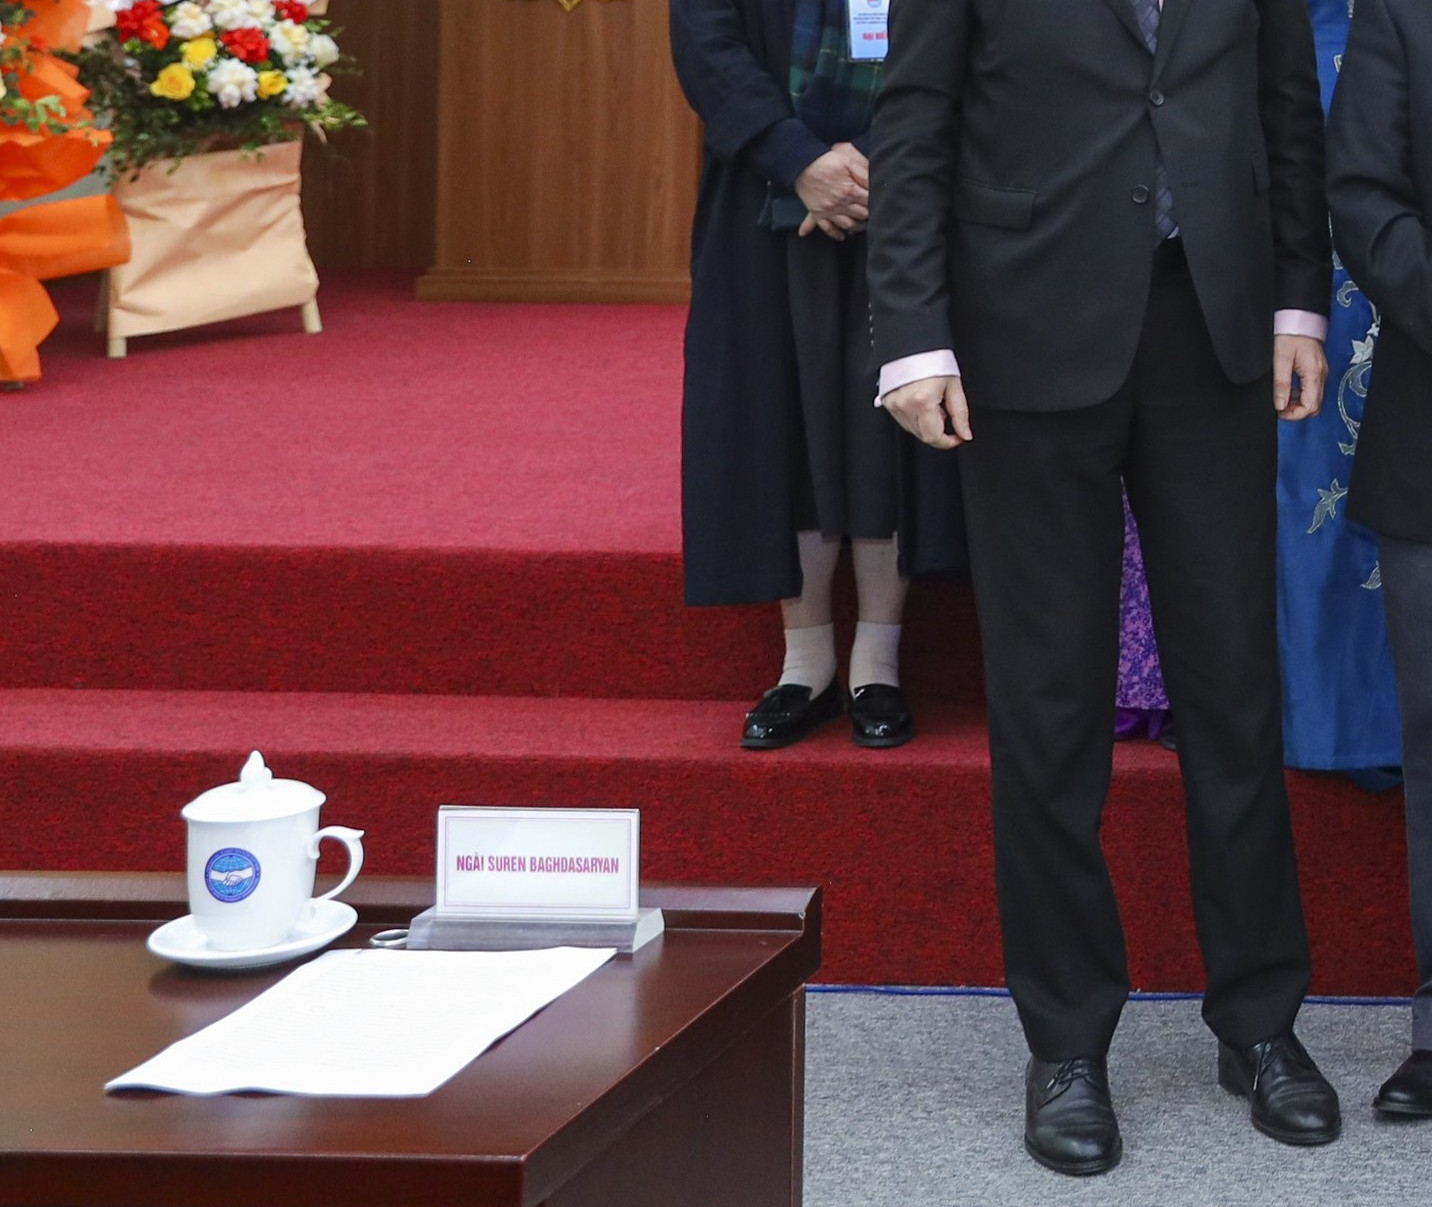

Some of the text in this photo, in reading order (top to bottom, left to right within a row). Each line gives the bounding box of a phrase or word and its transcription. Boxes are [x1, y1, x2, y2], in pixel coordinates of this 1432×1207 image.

[456, 852, 620, 874] NGÀI SUREN BAGHDASARYAN
